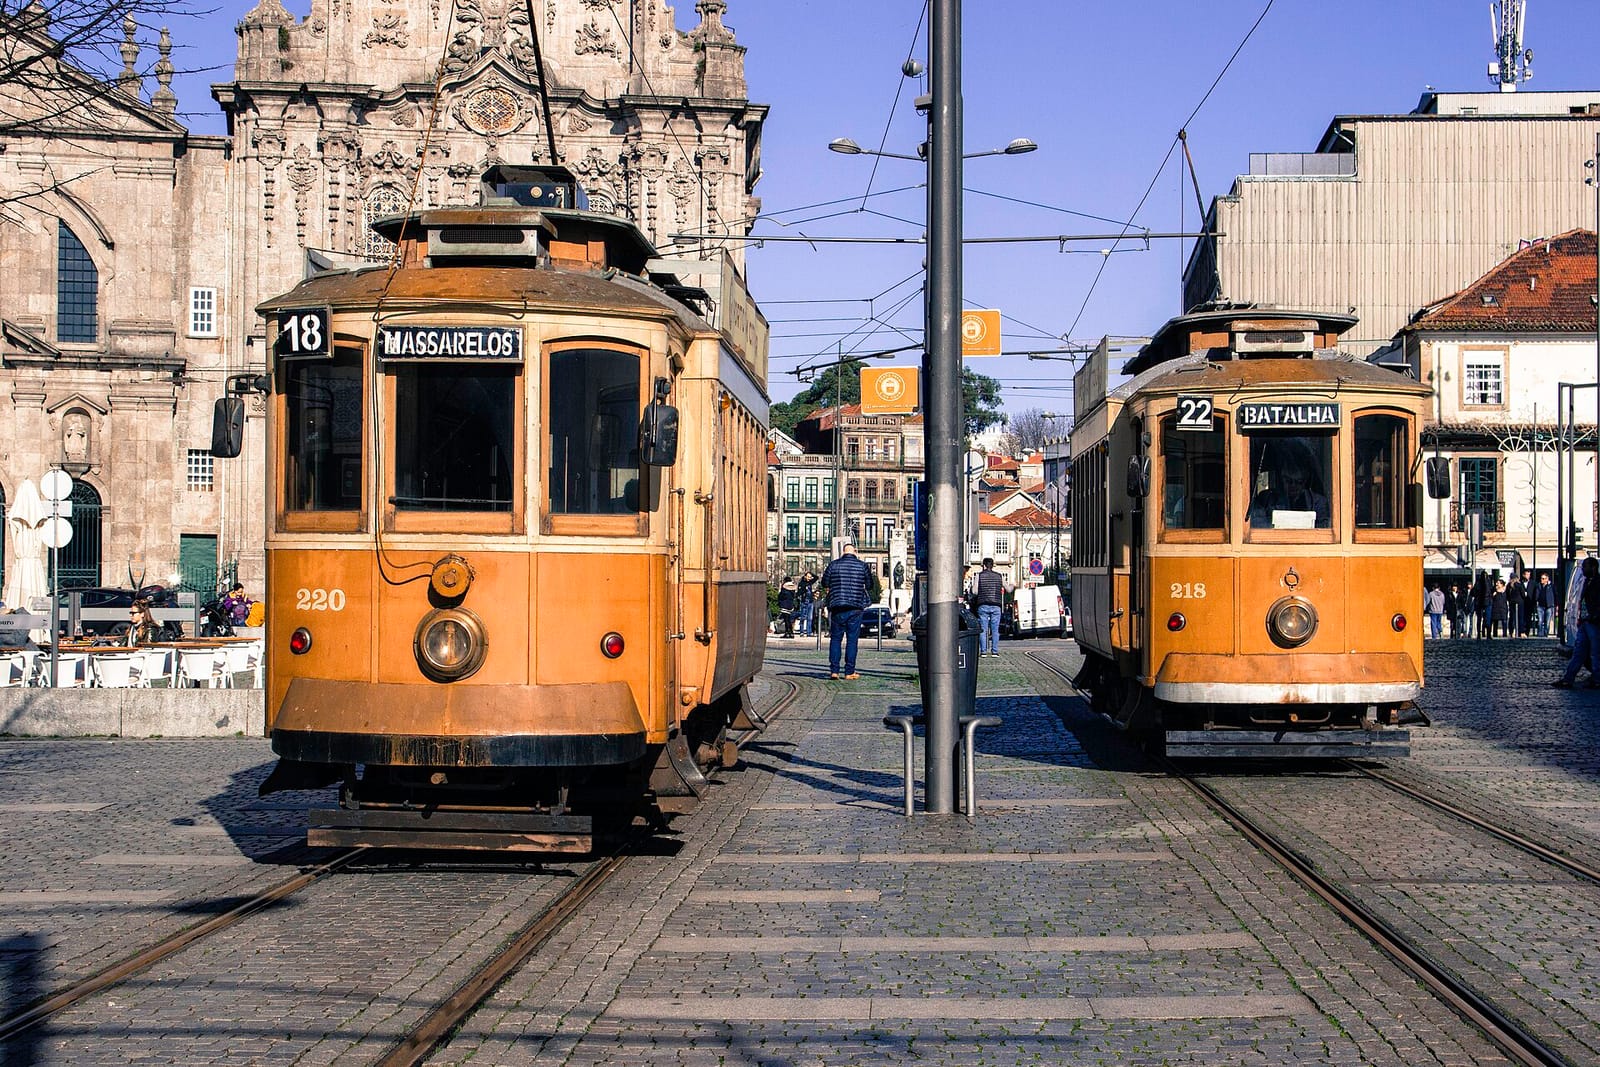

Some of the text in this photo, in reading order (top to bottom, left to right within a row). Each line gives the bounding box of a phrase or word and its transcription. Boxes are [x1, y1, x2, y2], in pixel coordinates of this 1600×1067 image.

[283, 314, 321, 351] 18
[384, 331, 513, 356] MASSARELOS
[1180, 399, 1211, 425] 22
[1244, 406, 1335, 423] BATALHA
[296, 588, 346, 611] 220
[1170, 582, 1207, 599] 218
